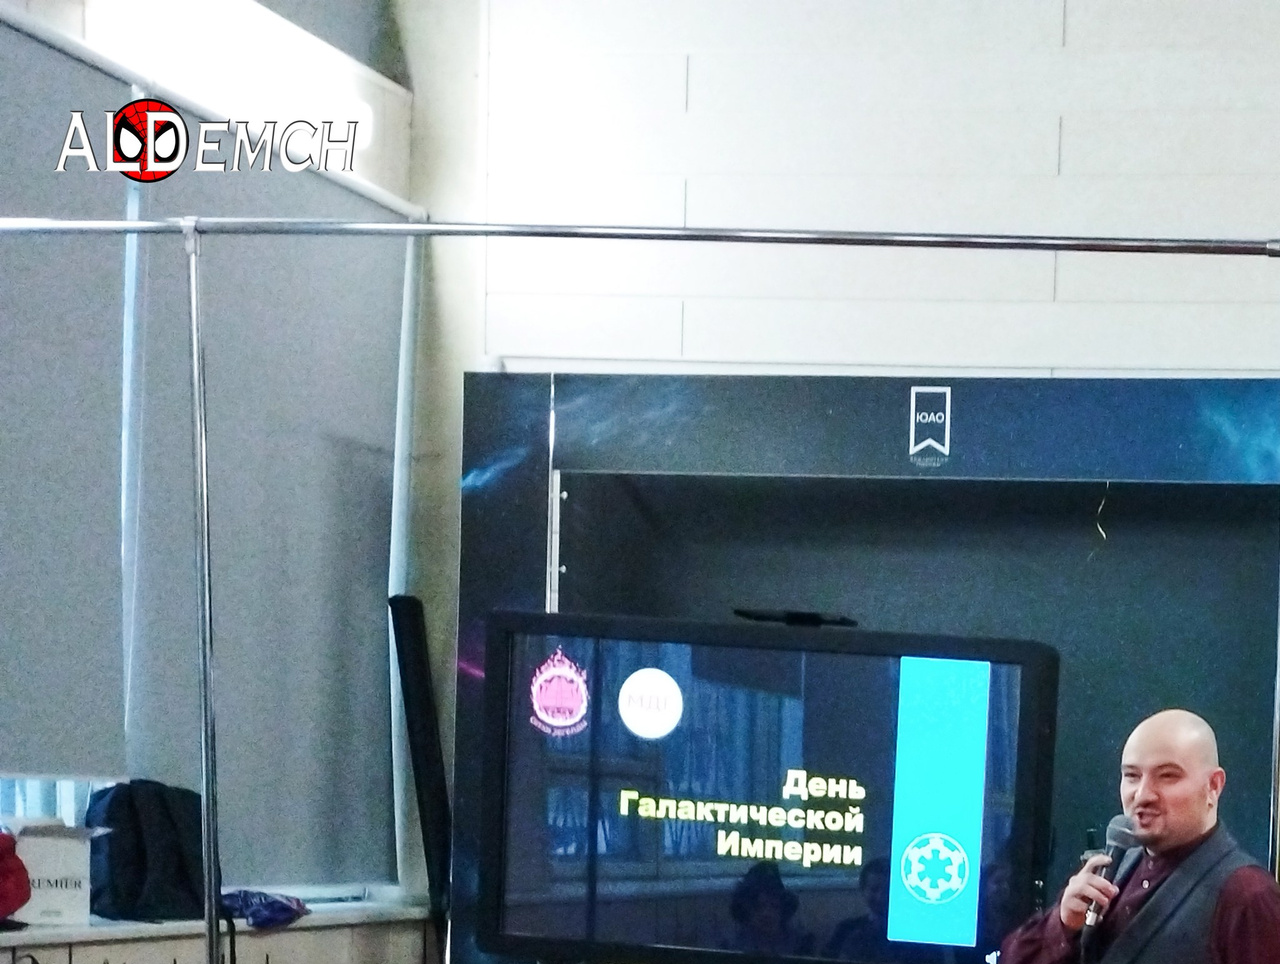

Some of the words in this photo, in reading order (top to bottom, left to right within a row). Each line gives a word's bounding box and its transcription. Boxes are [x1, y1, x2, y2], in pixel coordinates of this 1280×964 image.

[916, 411, 945, 424] ЮАО
[782, 769, 866, 800] День
[619, 789, 865, 833] Галактической
[717, 829, 863, 868] Империи
[30, 878, 82, 890] REMIER
